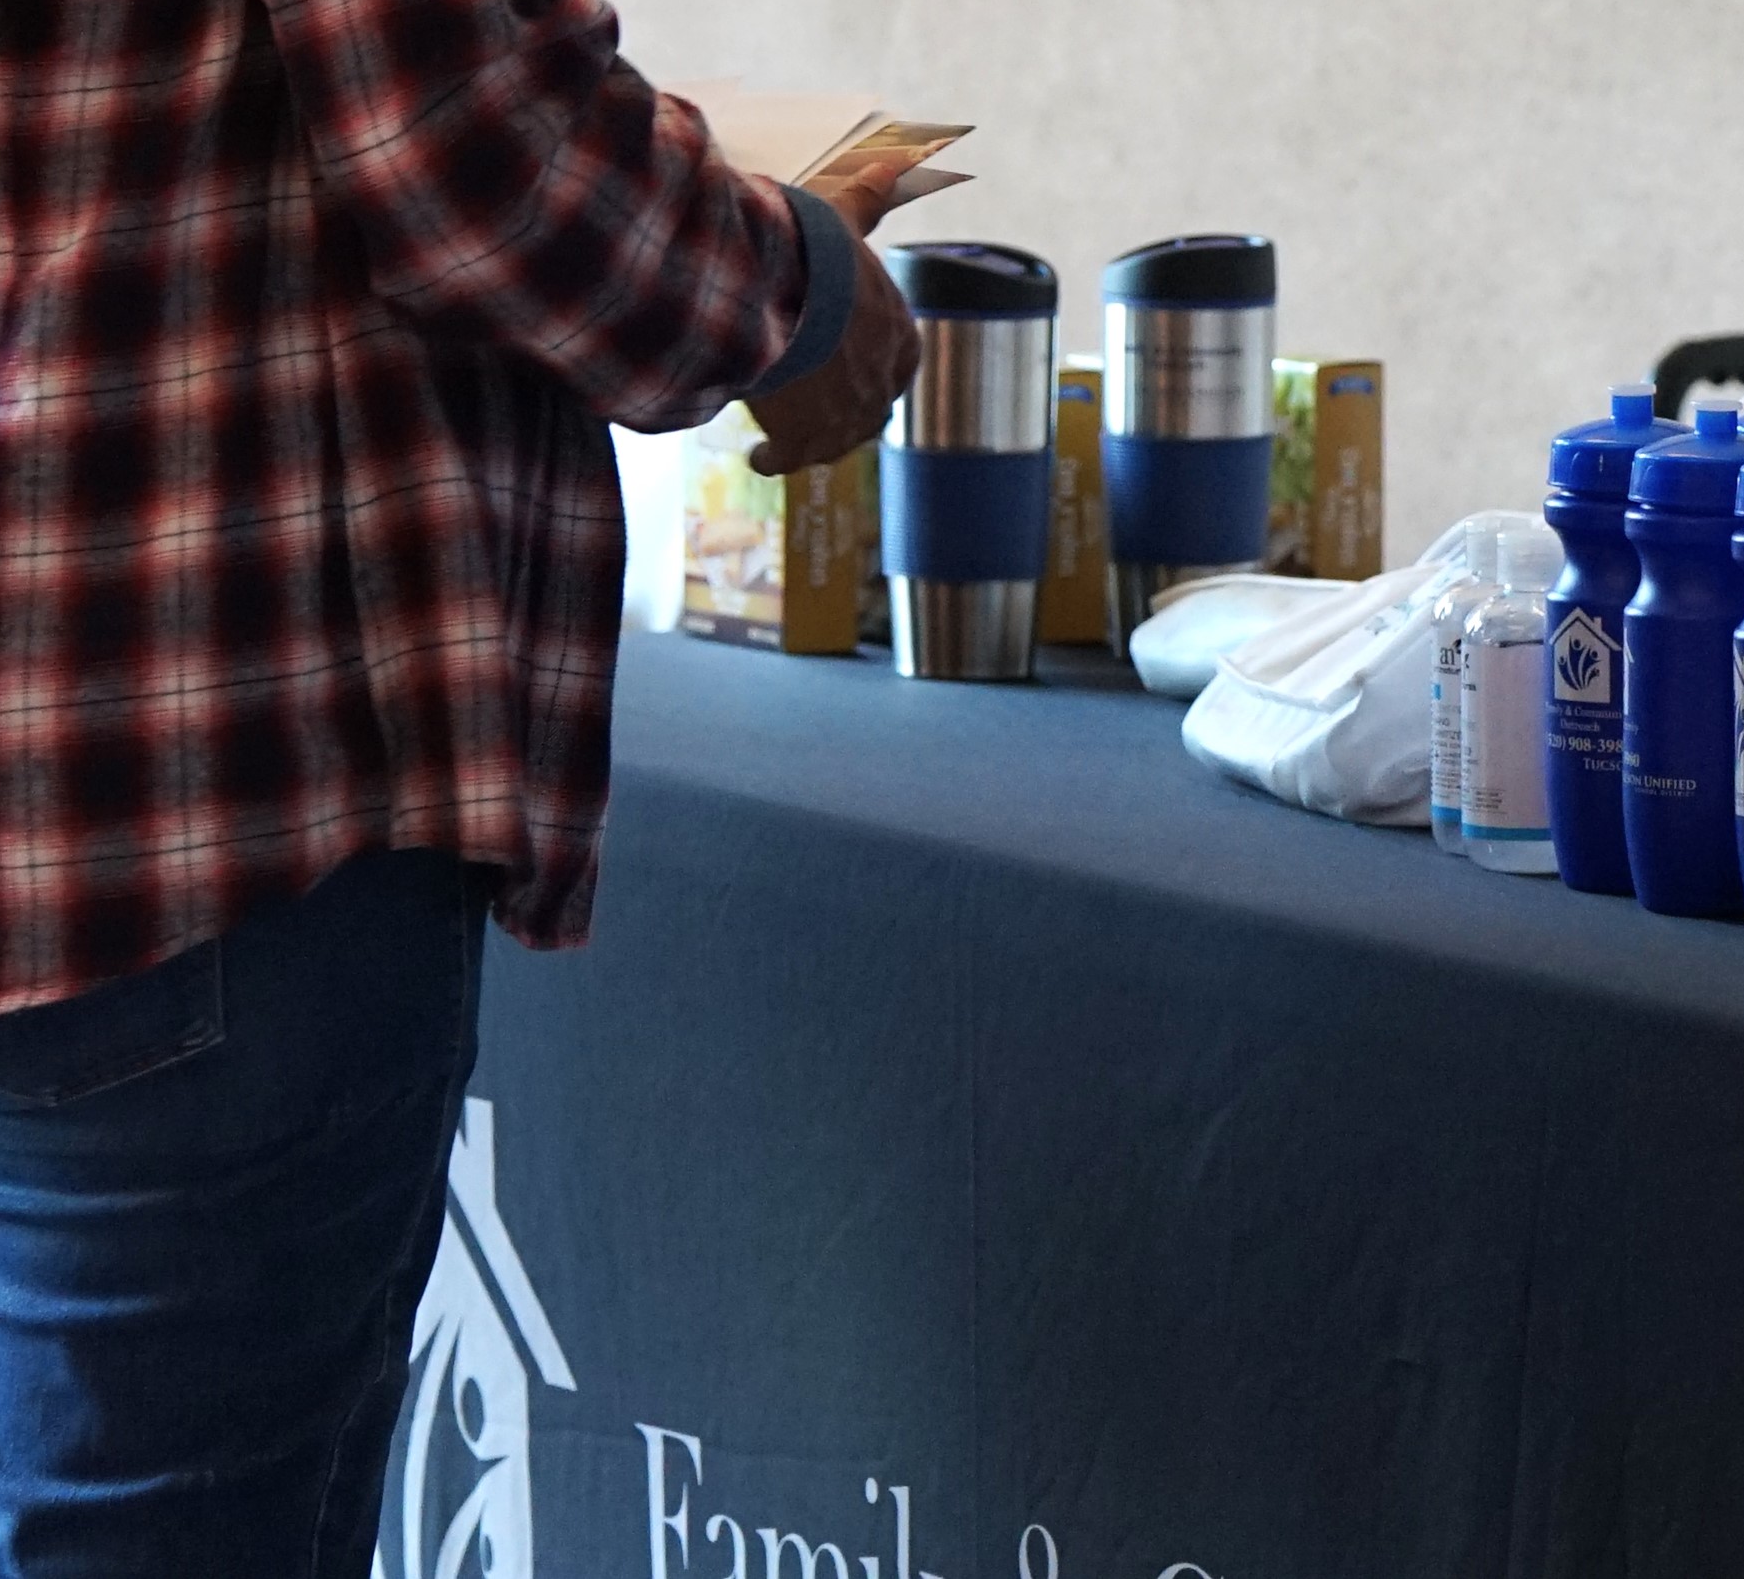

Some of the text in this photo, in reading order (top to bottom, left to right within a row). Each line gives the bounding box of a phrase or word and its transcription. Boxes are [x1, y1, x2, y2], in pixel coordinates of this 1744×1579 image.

[1568, 736, 1623, 753] 908-398
[1644, 775, 1697, 790] UNIFIED
[633, 1421, 945, 1579] Famil
